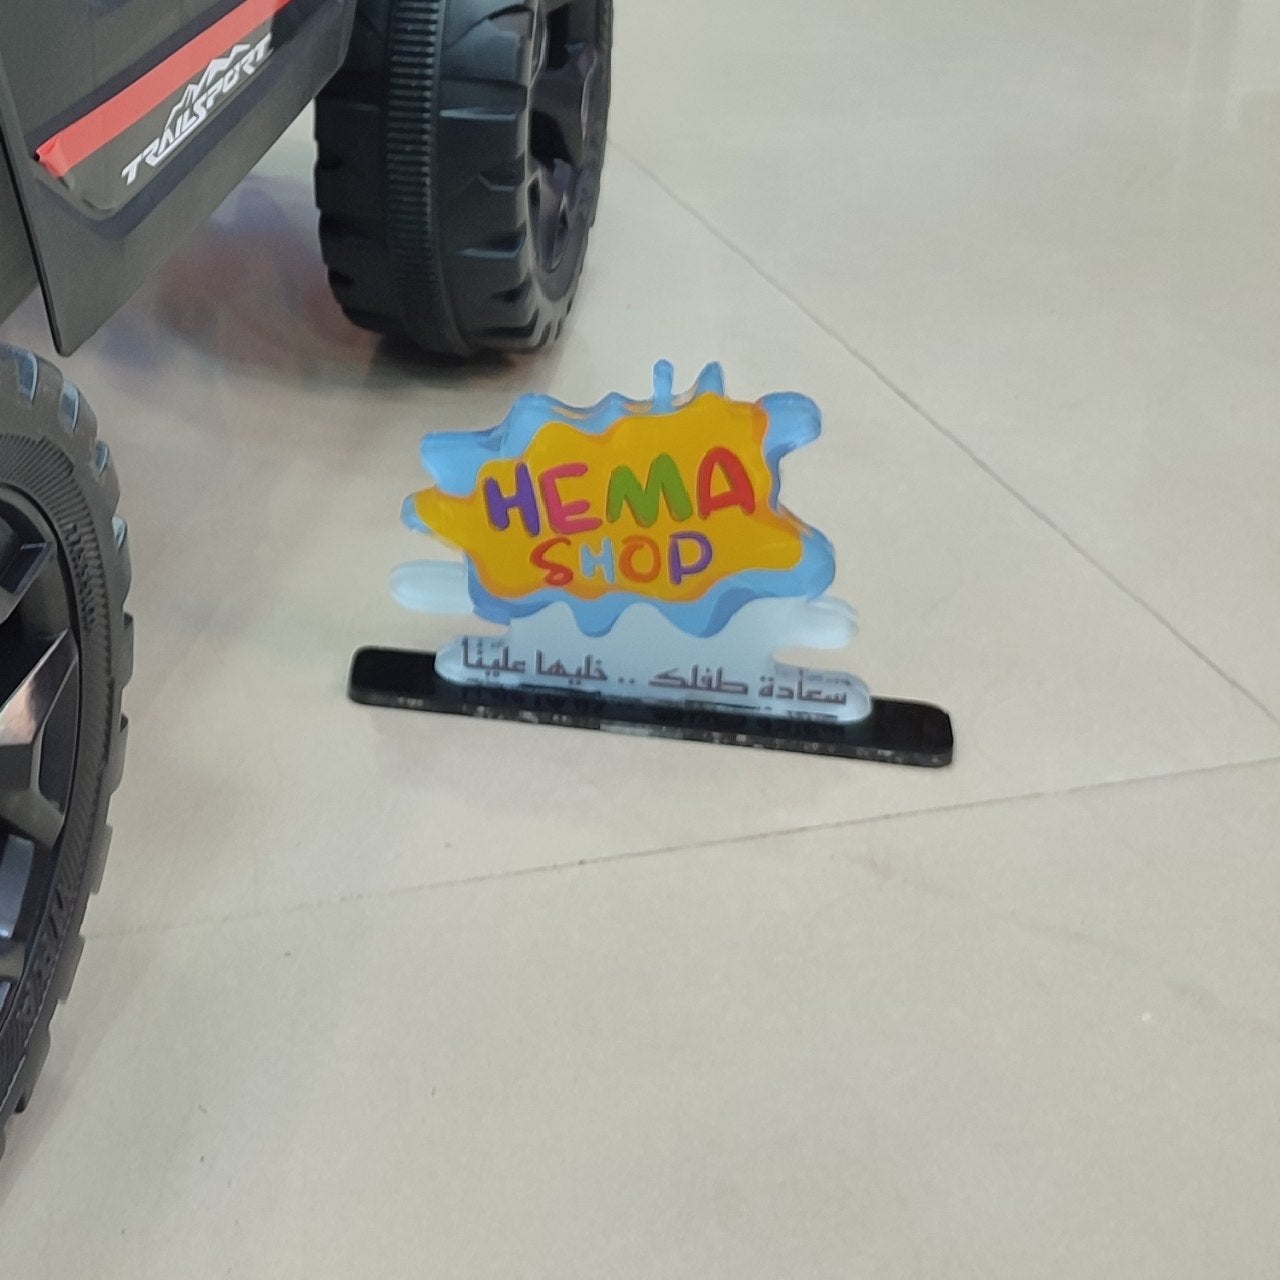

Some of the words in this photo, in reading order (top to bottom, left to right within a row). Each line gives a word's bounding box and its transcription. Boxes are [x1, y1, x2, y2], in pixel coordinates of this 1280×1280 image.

[121, 32, 274, 186] TRAILSPORT
[483, 446, 756, 538] HEMA
[530, 531, 713, 586] SHOP
[648, 664, 750, 697] طفلك
